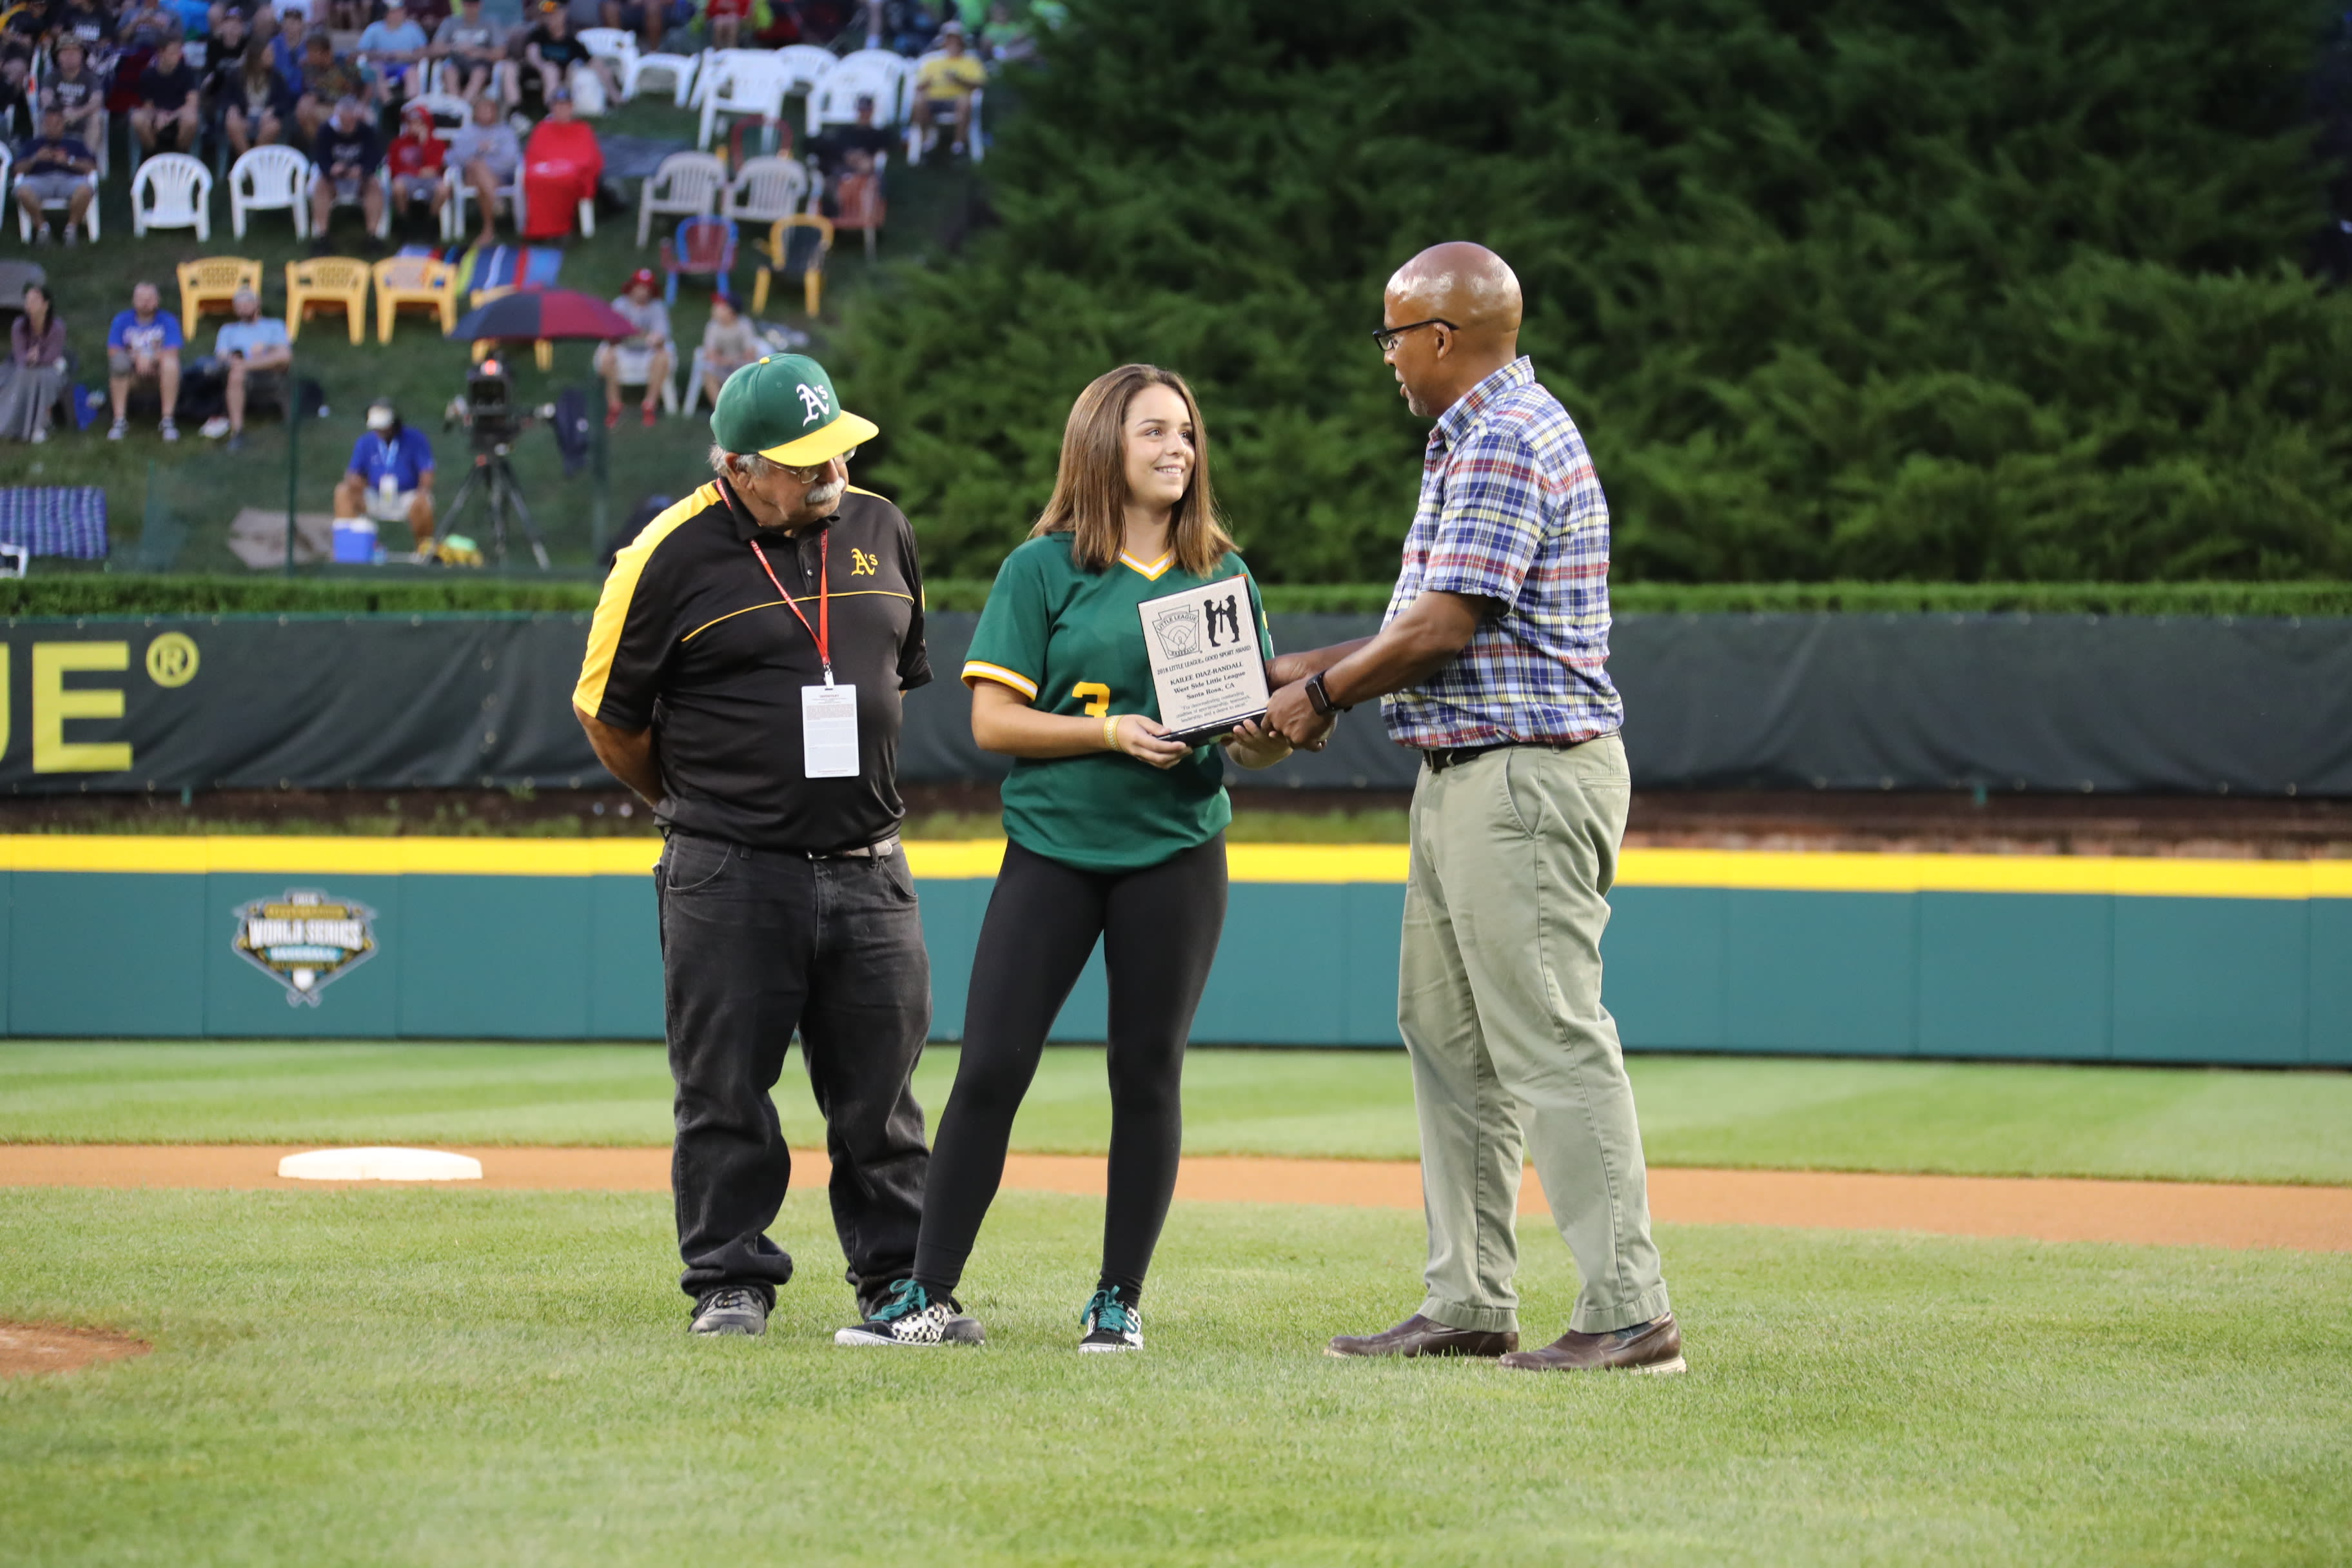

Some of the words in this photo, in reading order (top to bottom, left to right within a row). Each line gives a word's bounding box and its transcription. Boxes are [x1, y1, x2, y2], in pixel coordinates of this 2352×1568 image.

[796, 383, 830, 427] A's
[851, 548, 878, 576] A's
[1157, 618, 1173, 631] LITTLE
[1174, 613, 1197, 622] LEAGUE
[1170, 675, 1193, 685] KAILEE
[1195, 662, 1243, 678] DIAZ-RANDALL
[1224, 670, 1246, 681] League
[1186, 691, 1204, 699] Santa
[1206, 686, 1223, 695] Rosa,
